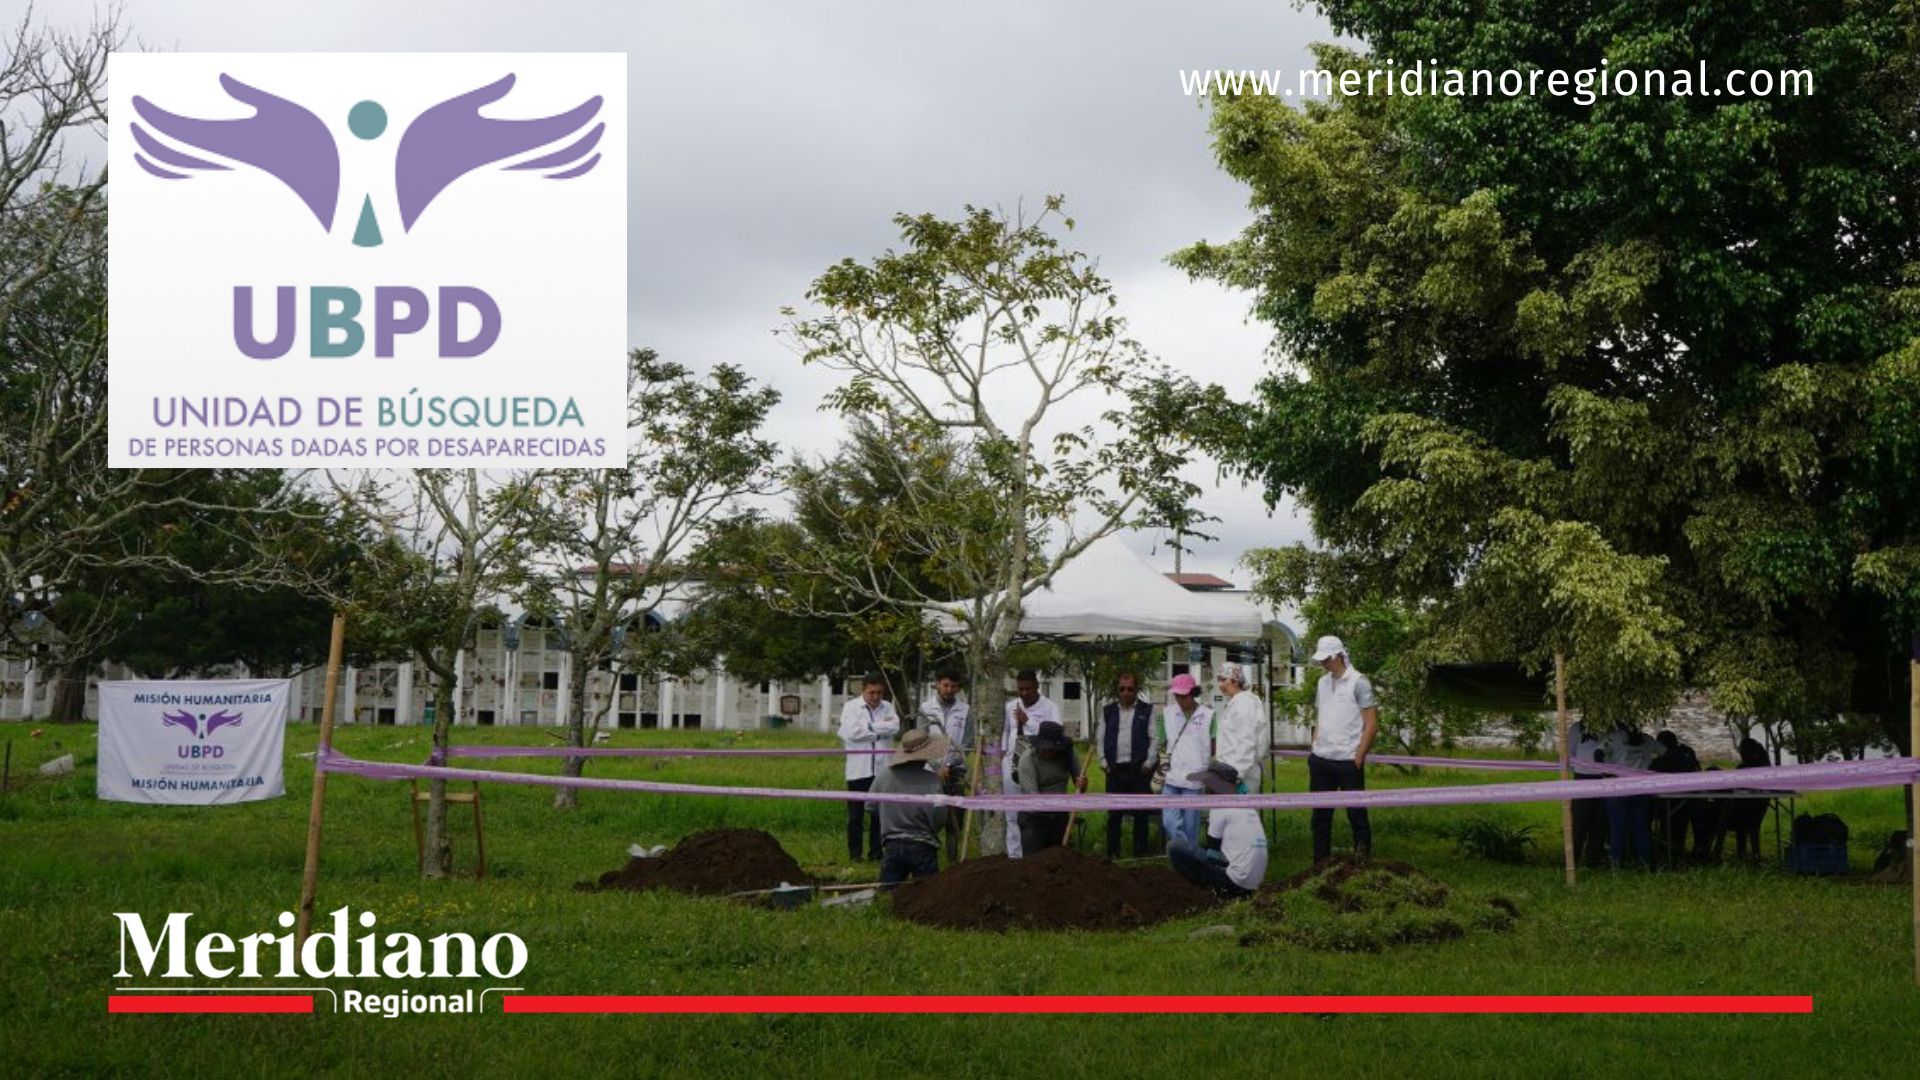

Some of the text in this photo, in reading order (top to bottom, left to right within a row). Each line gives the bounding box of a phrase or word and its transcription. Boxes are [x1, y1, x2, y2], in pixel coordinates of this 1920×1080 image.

[134, 692, 272, 705] MISIÓN HUMANITARIA
[178, 745, 224, 759] UBPD
